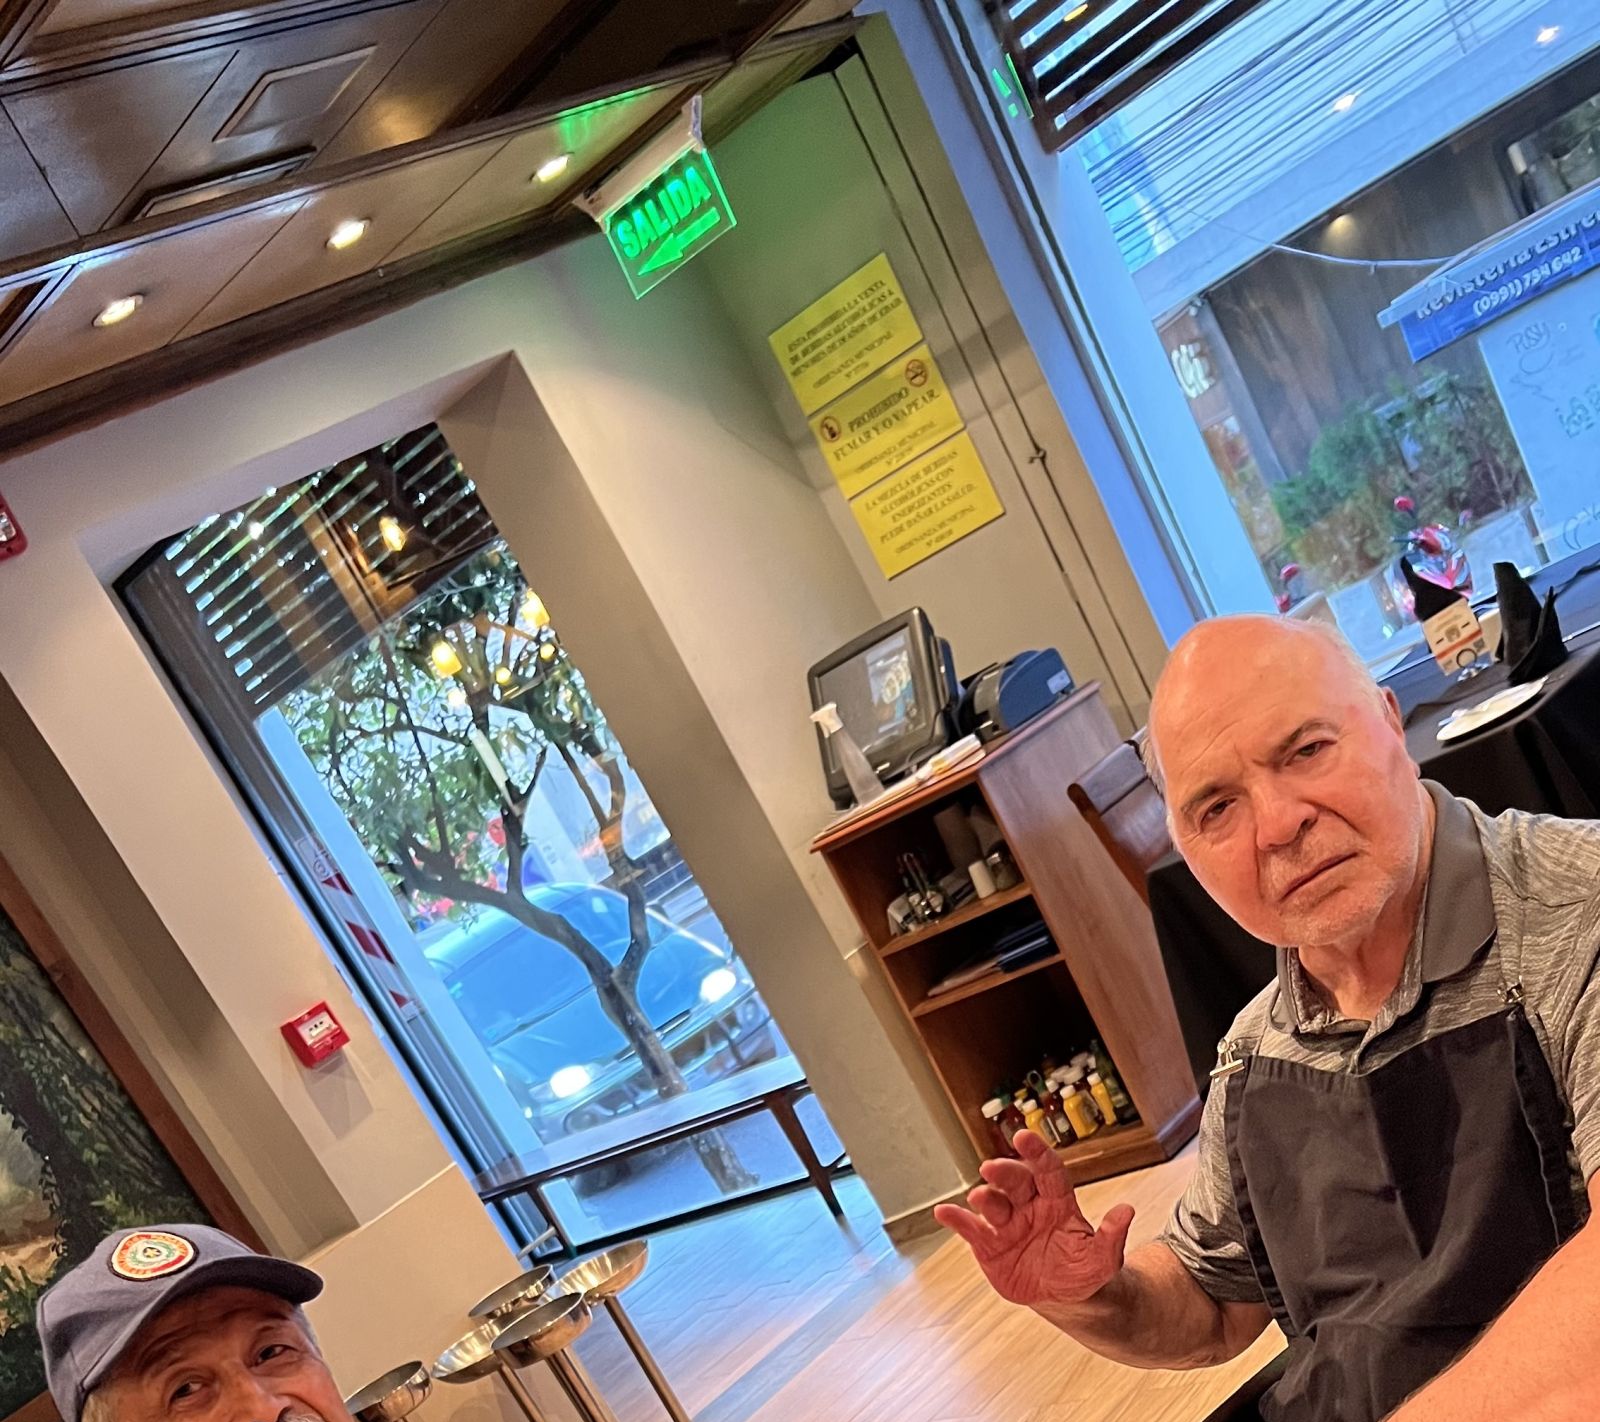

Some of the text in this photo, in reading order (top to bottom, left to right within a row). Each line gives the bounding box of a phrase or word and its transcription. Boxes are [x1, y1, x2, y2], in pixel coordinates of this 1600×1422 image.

[617, 165, 712, 259] SALIDA
[1473, 279, 1523, 317] (0991)
[1551, 246, 1583, 271] 642
[847, 387, 910, 432] PROHIBIDO
[832, 430, 874, 462] FUMAR
